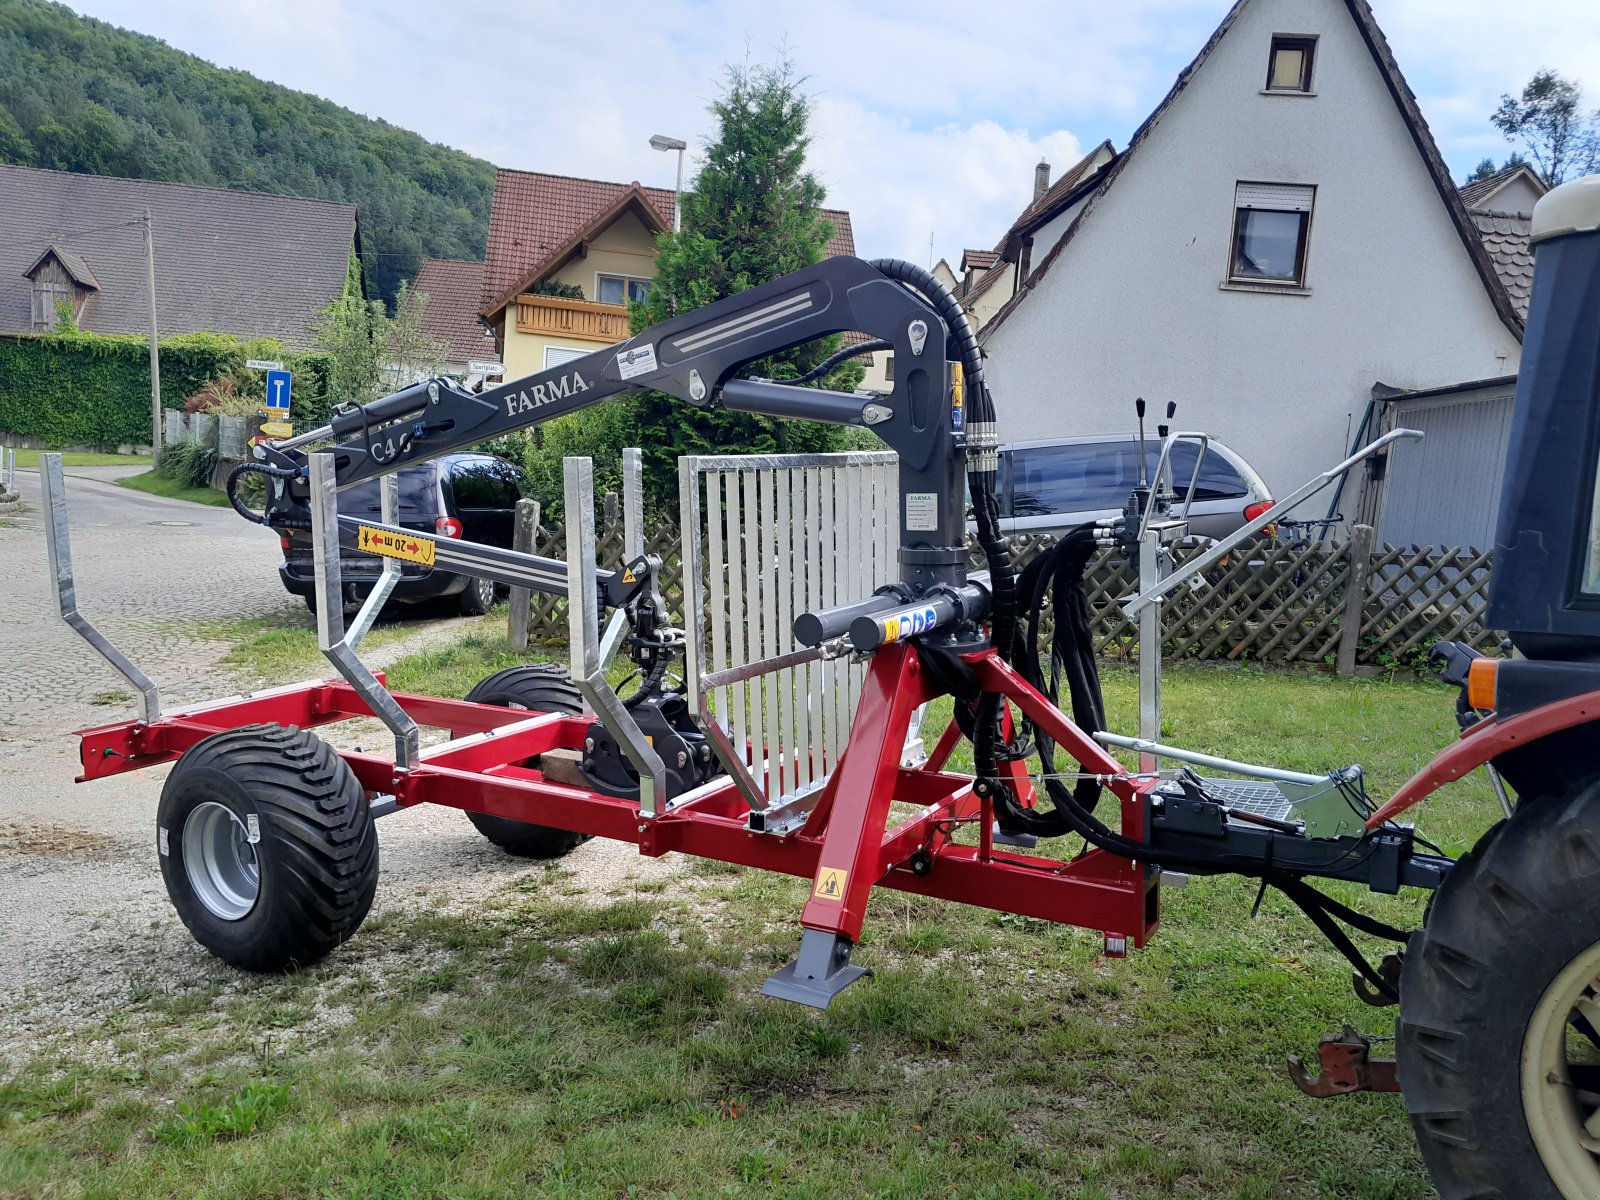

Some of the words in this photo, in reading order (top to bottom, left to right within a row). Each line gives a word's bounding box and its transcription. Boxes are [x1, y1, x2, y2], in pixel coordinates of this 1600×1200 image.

[473, 363, 497, 371] Sportplatz
[384, 536, 393, 547] m
[394, 538, 406, 552] 20
